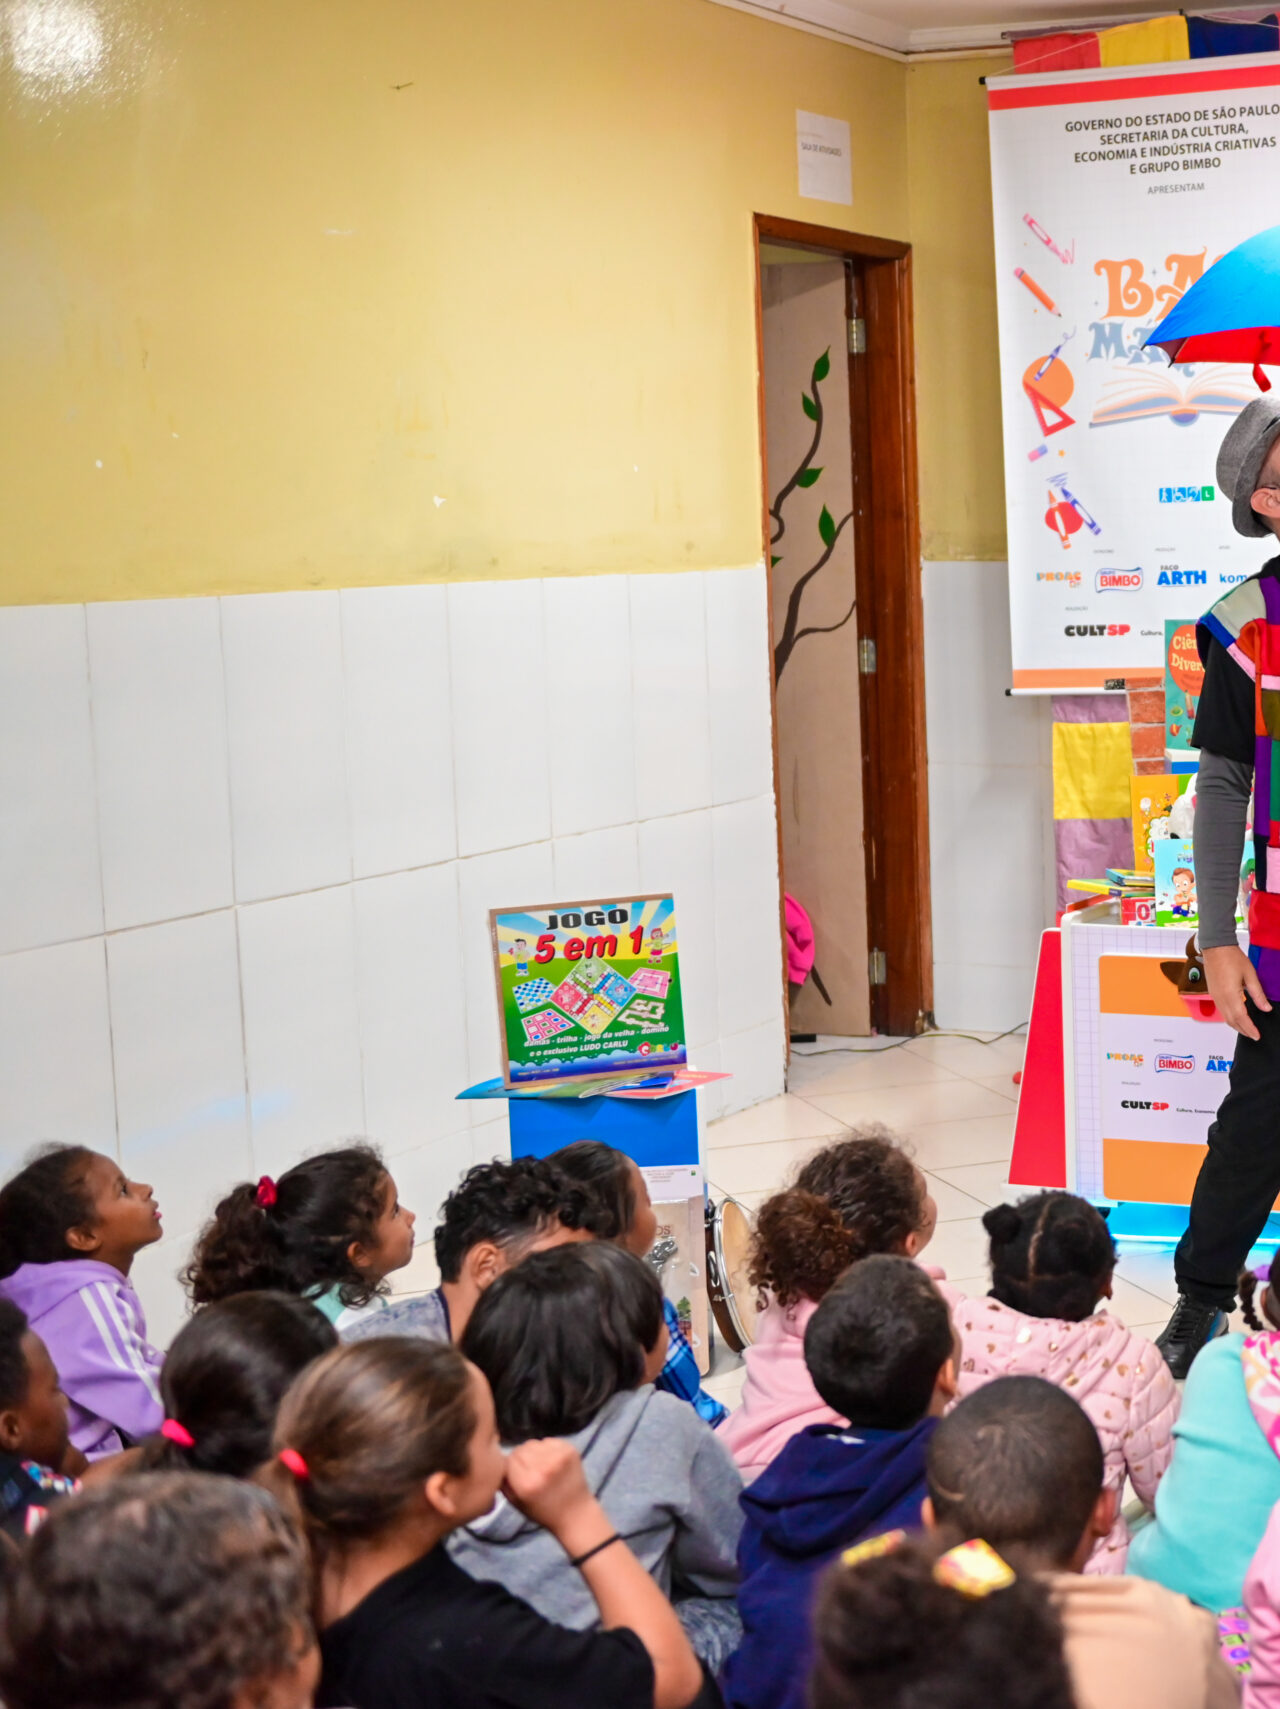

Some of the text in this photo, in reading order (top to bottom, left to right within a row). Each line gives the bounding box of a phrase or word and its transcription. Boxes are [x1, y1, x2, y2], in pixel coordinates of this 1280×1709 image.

[1065, 117, 1122, 132] GOVERNO
[1125, 116, 1142, 128] DO
[1145, 112, 1191, 126] ESTADO
[1194, 110, 1209, 122] DE
[1212, 106, 1236, 120] SÃO
[1100, 123, 1249, 145] SECRETARIA DA CULTURA,
[1074, 136, 1277, 163] ECONOMIA E INDÚSTRIA CRIATIVAS
[1130, 157, 1221, 175] E GRUPO BIMBO
[1147, 182, 1205, 195] APRESENTAM
[1094, 245, 1225, 322] BA
[1100, 575, 1141, 587] BIMBO
[1157, 570, 1207, 585] ARTH
[1064, 624, 1131, 637] CULTSP
[546, 908, 629, 931] JOGO
[534, 924, 644, 964] 5 em 1
[524, 1025, 670, 1047] damas trilha jogo da velha dominó
[543, 1046, 578, 1056] exclusivo
[579, 1043, 601, 1052] LUDO
[602, 1040, 629, 1049] CARLU
[1158, 1059, 1193, 1070] BIMBO
[1206, 1060, 1234, 1072] ART
[1121, 1100, 1169, 1111] CULTSP
